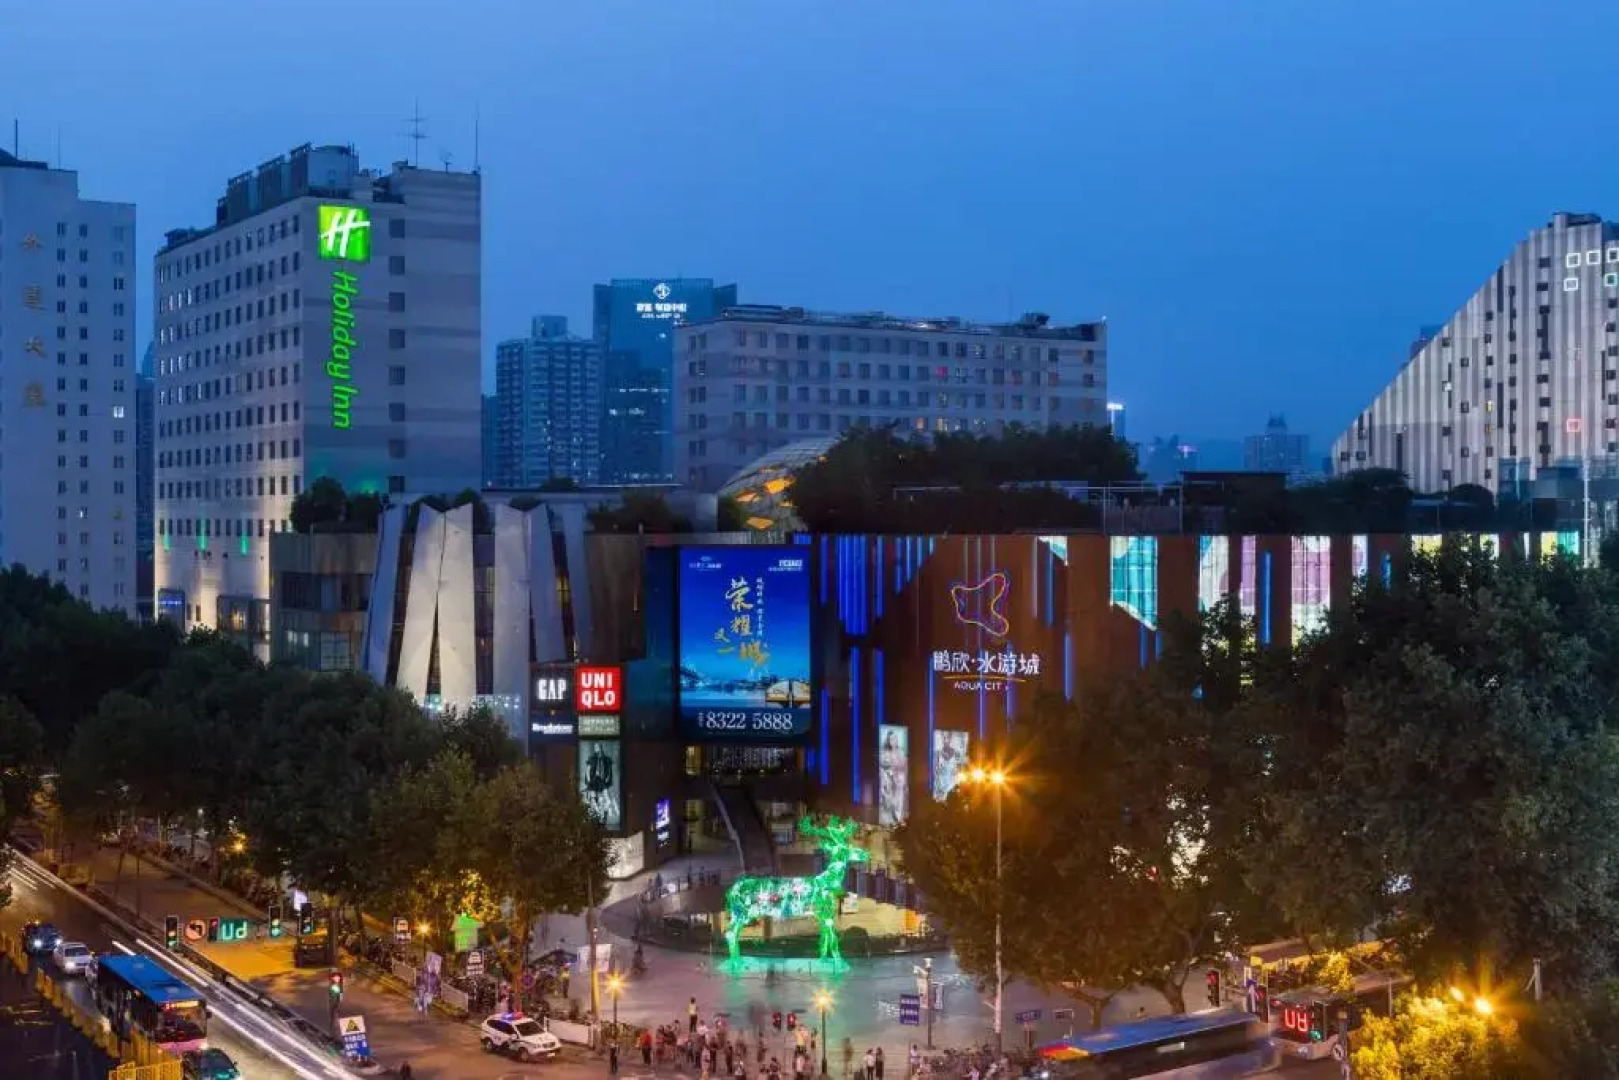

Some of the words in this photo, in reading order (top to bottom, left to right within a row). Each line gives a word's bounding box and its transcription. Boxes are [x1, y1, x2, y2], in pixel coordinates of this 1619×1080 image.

[327, 271, 358, 379] Holiday
[333, 385, 359, 429] Inn
[538, 678, 567, 701] GAP
[581, 672, 613, 689] UNI
[581, 690, 616, 709] QLO
[706, 711, 746, 730] 8322
[752, 711, 793, 730] 5888
